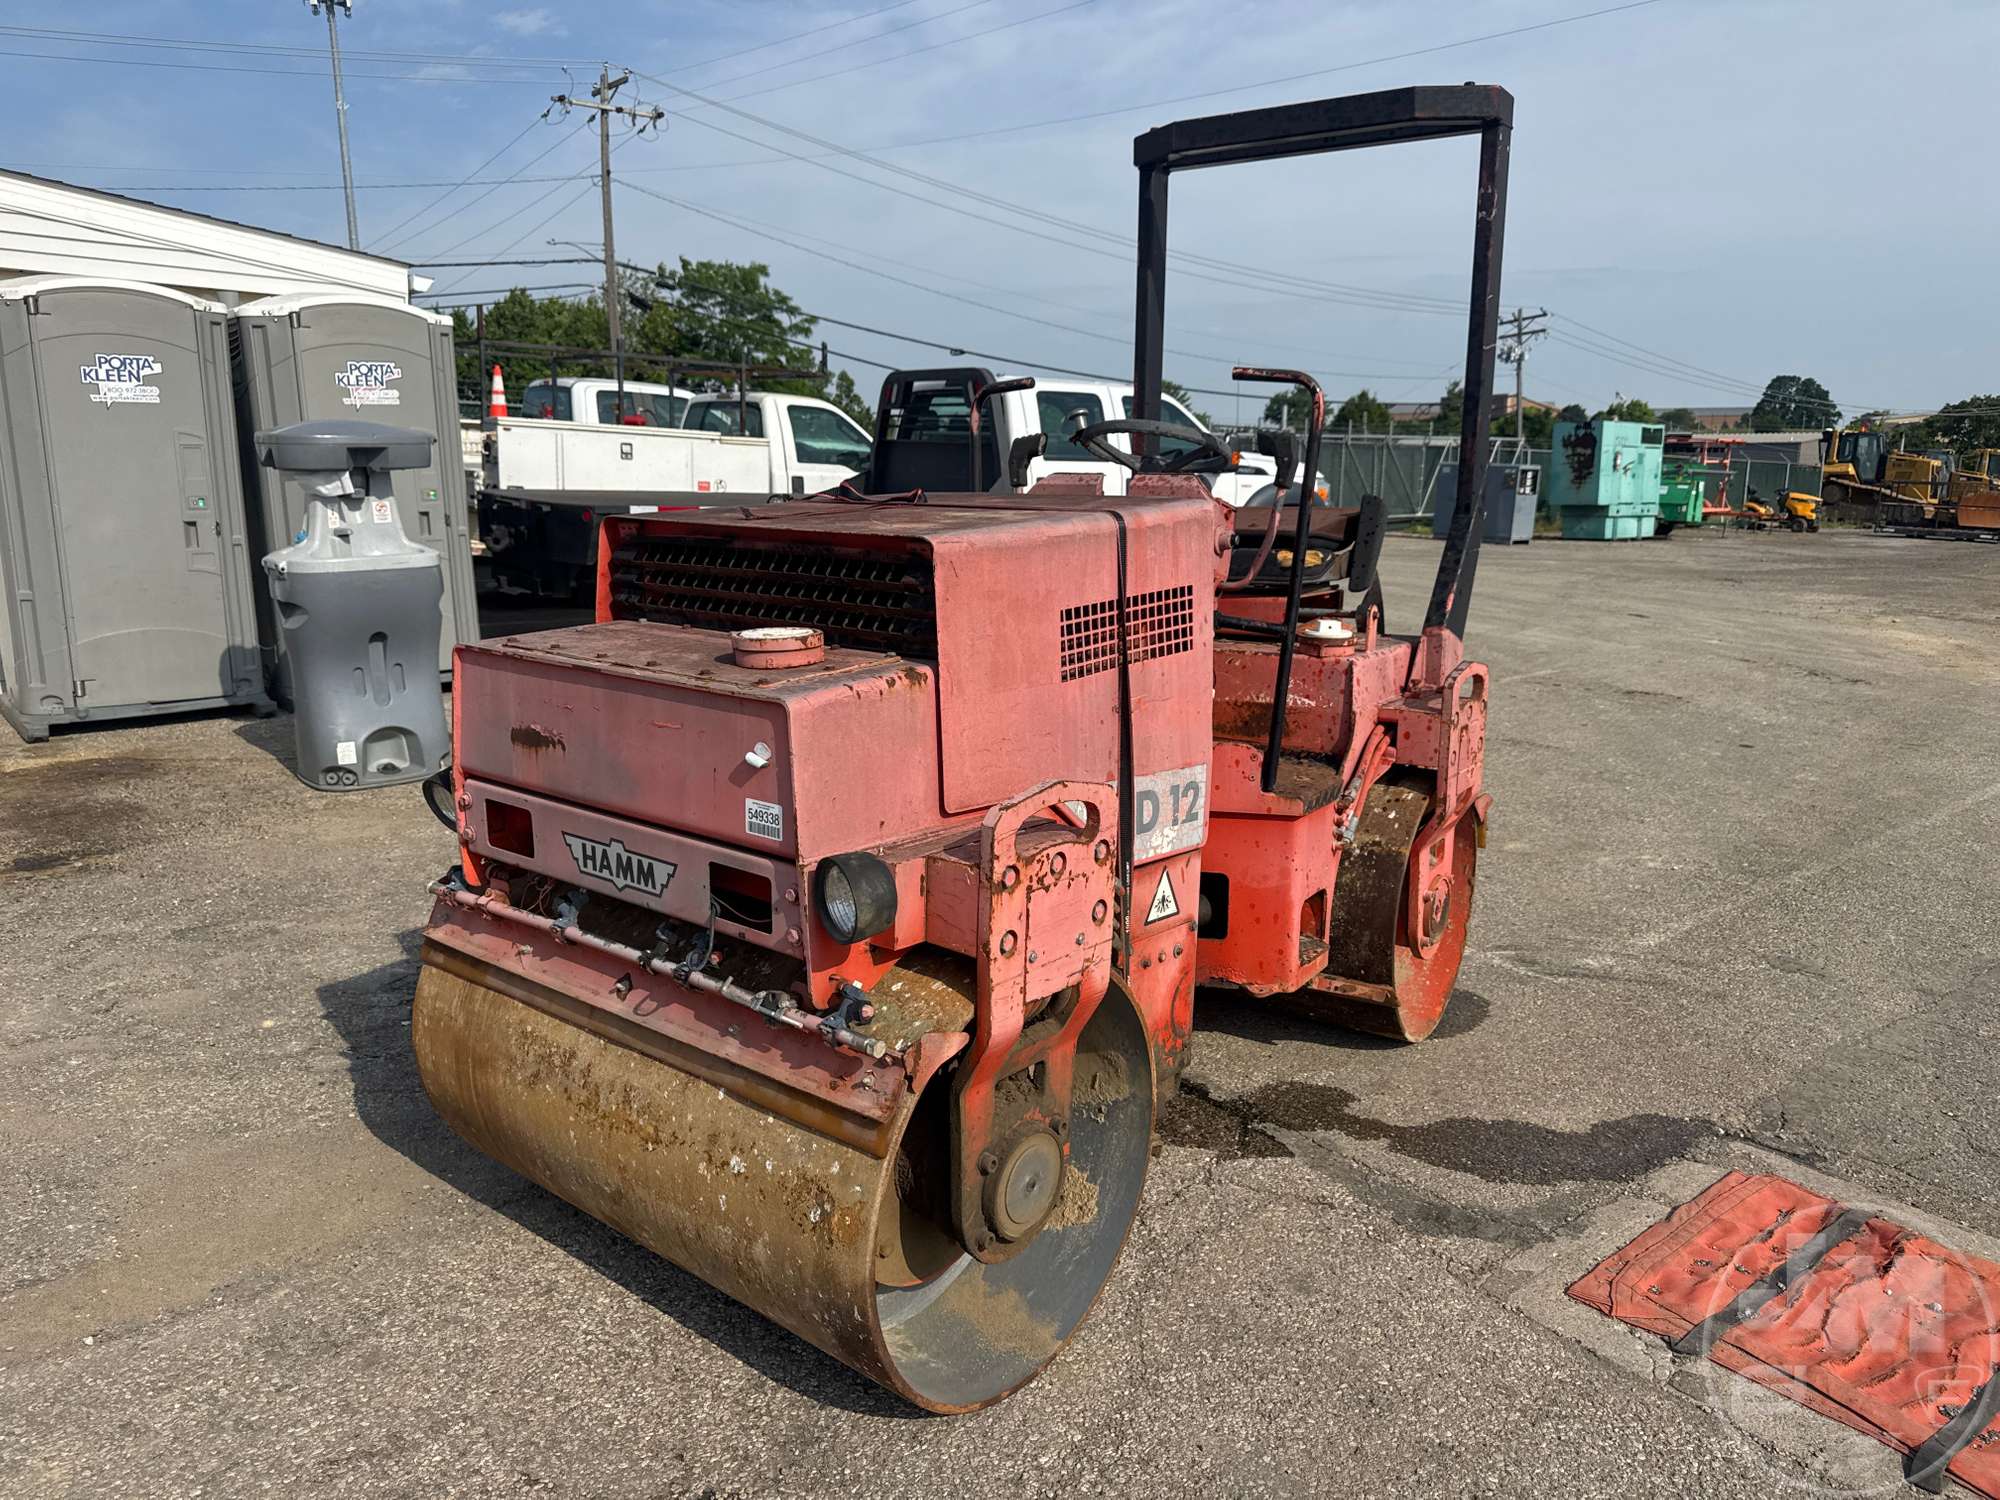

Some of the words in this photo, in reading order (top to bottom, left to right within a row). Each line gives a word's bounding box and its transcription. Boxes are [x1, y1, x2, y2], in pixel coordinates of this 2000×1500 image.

[97, 356, 154, 371] PORTA
[349, 363, 394, 376] PORTA
[82, 368, 141, 383] KLEEN
[337, 374, 385, 387] KLEEN
[1169, 780, 1200, 827] 12
[748, 807, 780, 826] 549338
[581, 842, 657, 890] HAMM
